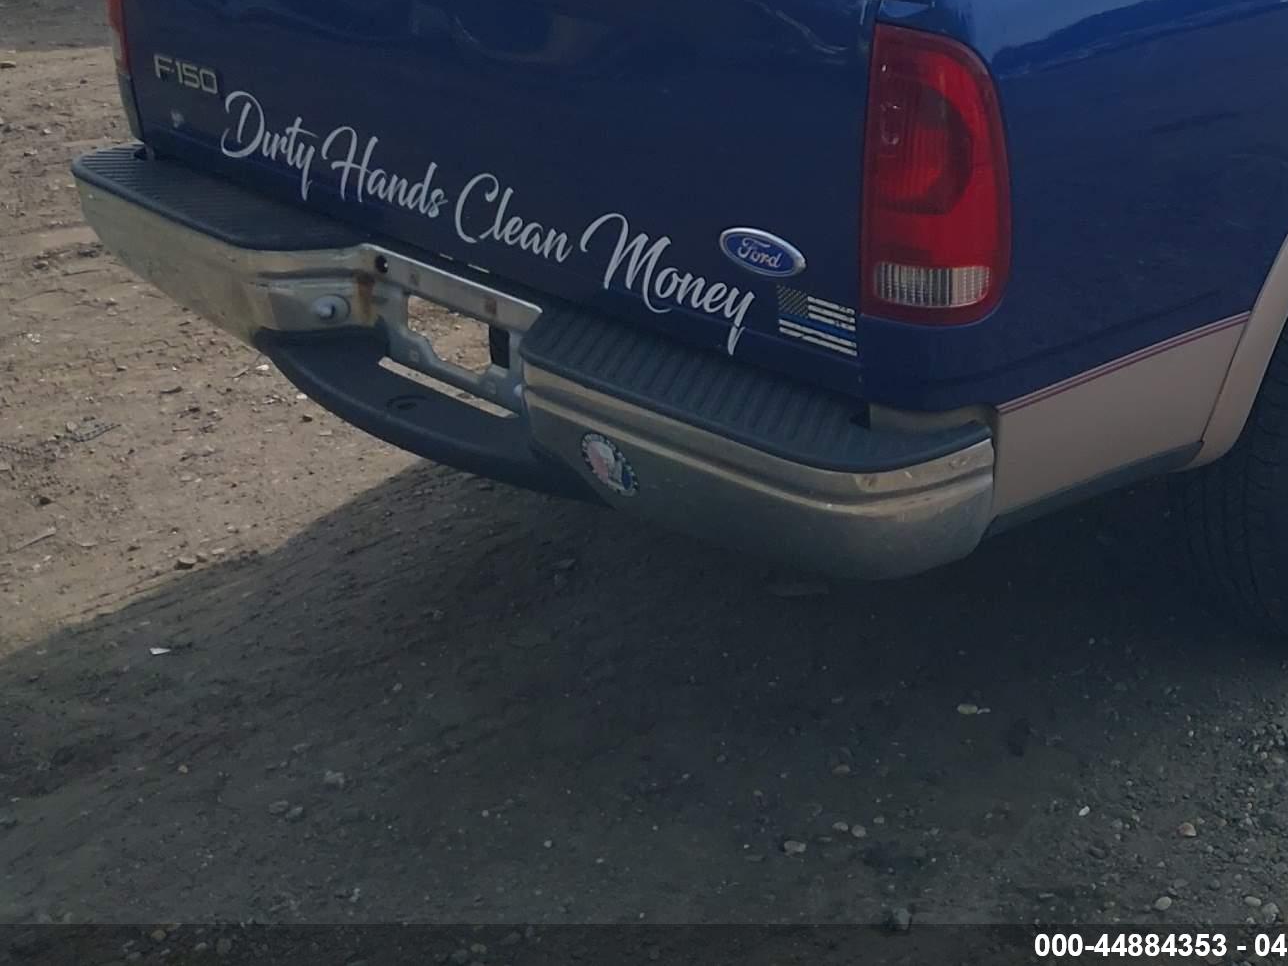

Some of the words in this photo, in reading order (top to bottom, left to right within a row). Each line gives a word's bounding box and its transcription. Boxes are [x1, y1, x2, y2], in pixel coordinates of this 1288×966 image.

[220, 90, 319, 202] Dirty
[321, 126, 448, 218] Hands
[455, 173, 573, 263] Clean
[580, 212, 755, 356] Money
[737, 237, 783, 269] Ford
